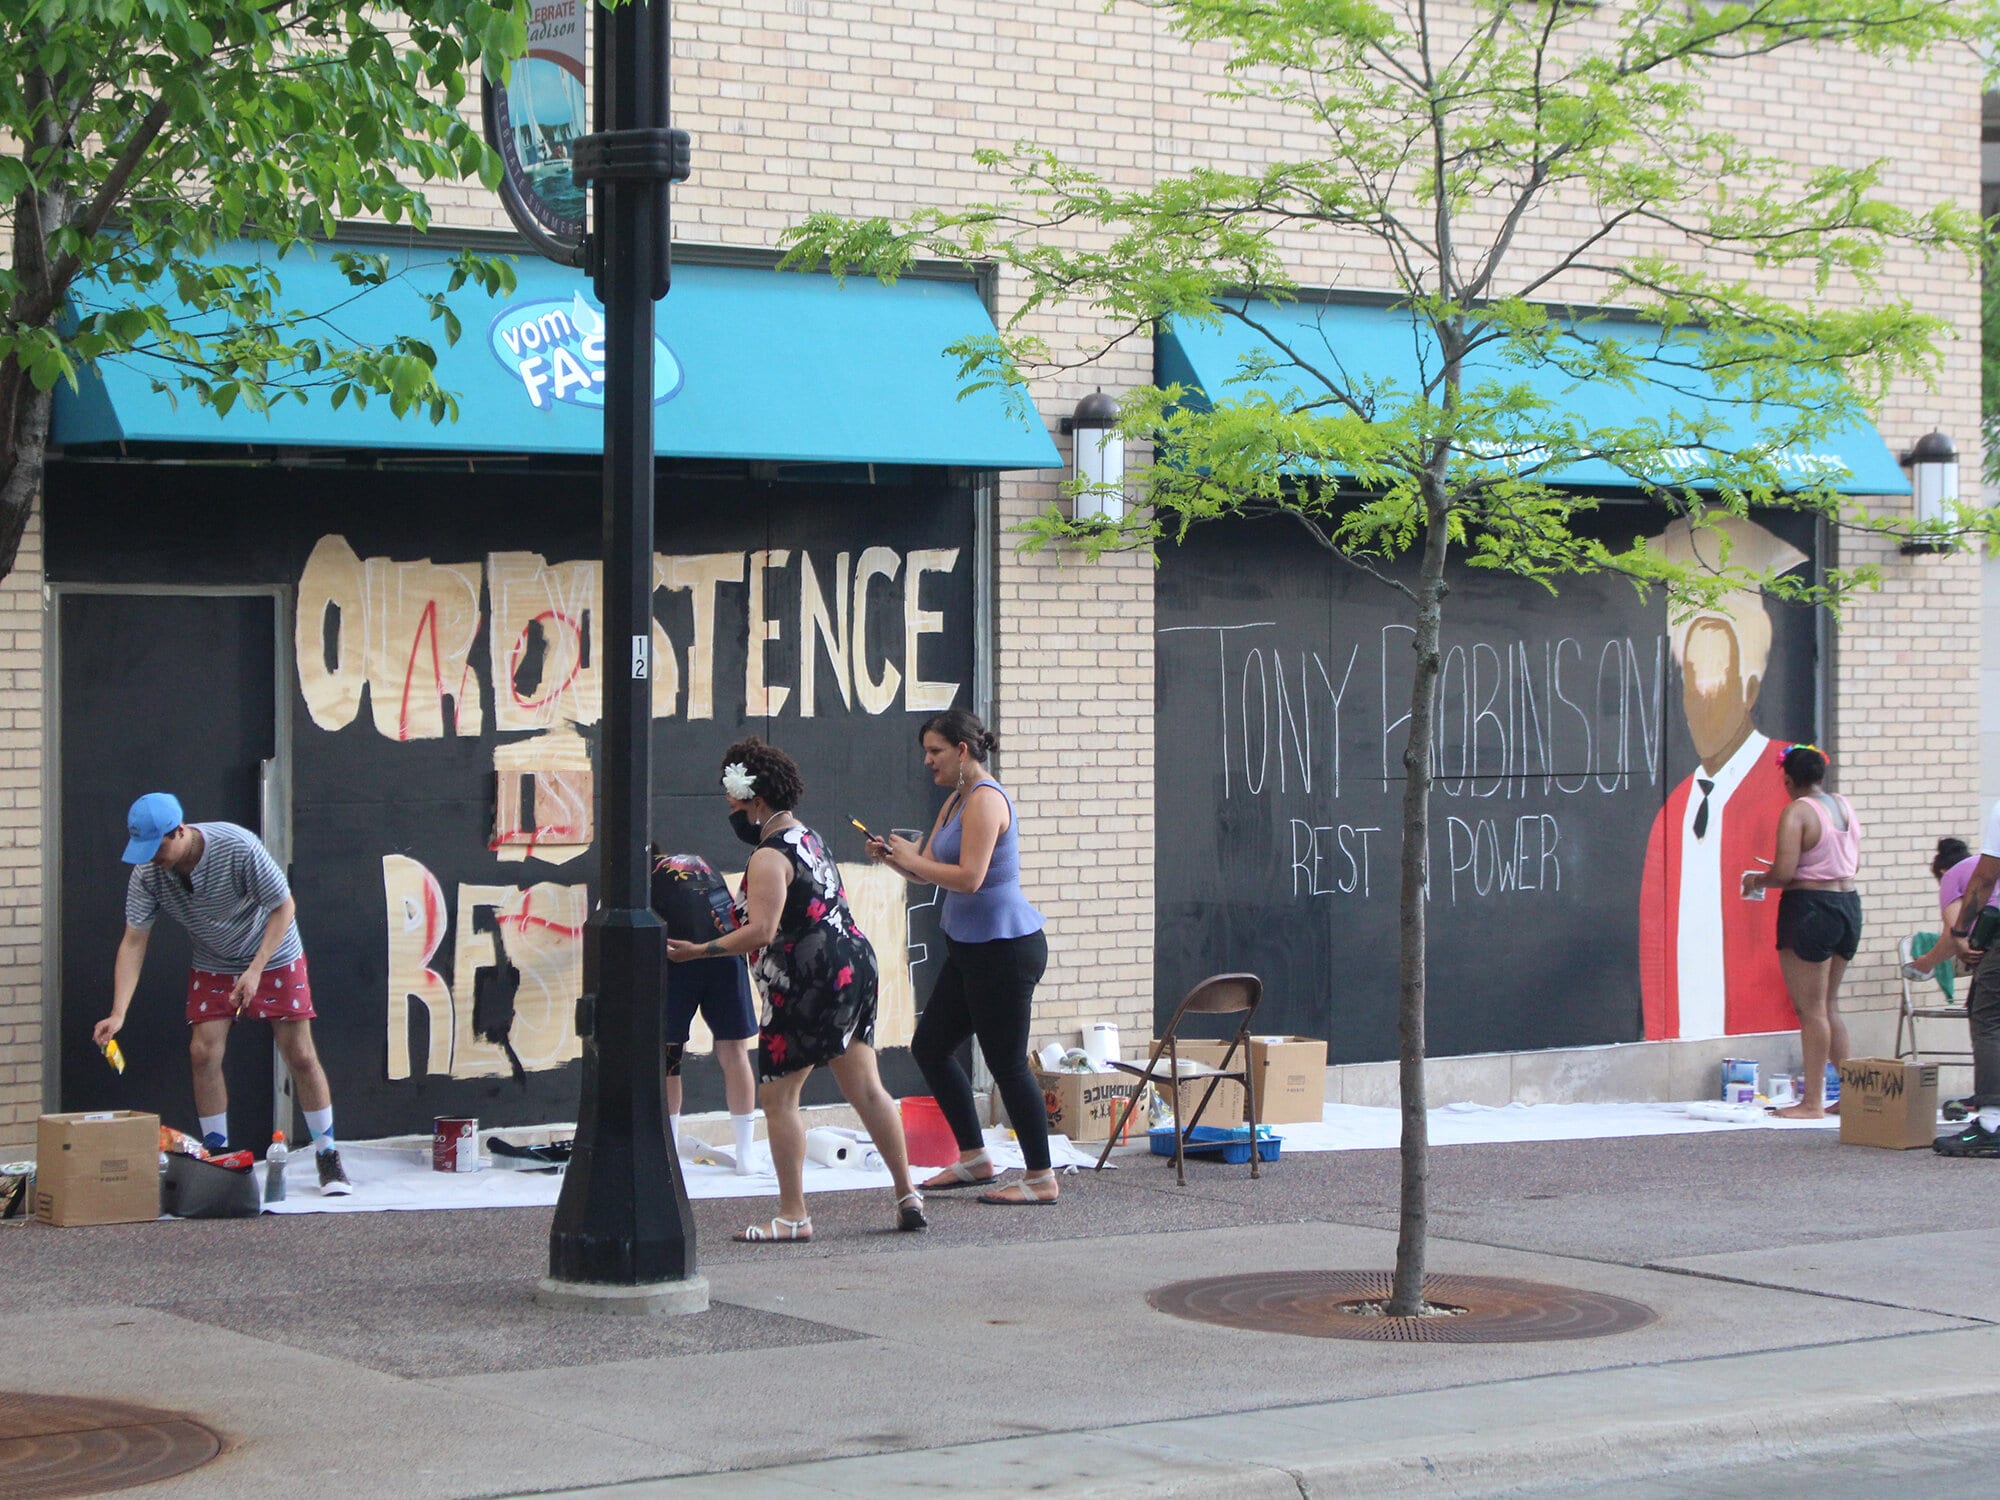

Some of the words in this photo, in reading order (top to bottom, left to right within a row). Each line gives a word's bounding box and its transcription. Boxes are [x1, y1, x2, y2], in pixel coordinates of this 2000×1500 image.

[524, 0, 576, 25] EBRATE
[526, 20, 576, 42] adison
[501, 308, 571, 355] vom
[518, 334, 606, 408] FAS
[1158, 621, 1359, 799] TONY
[1290, 818, 1381, 898] REST
[1447, 813, 1561, 907] POWER
